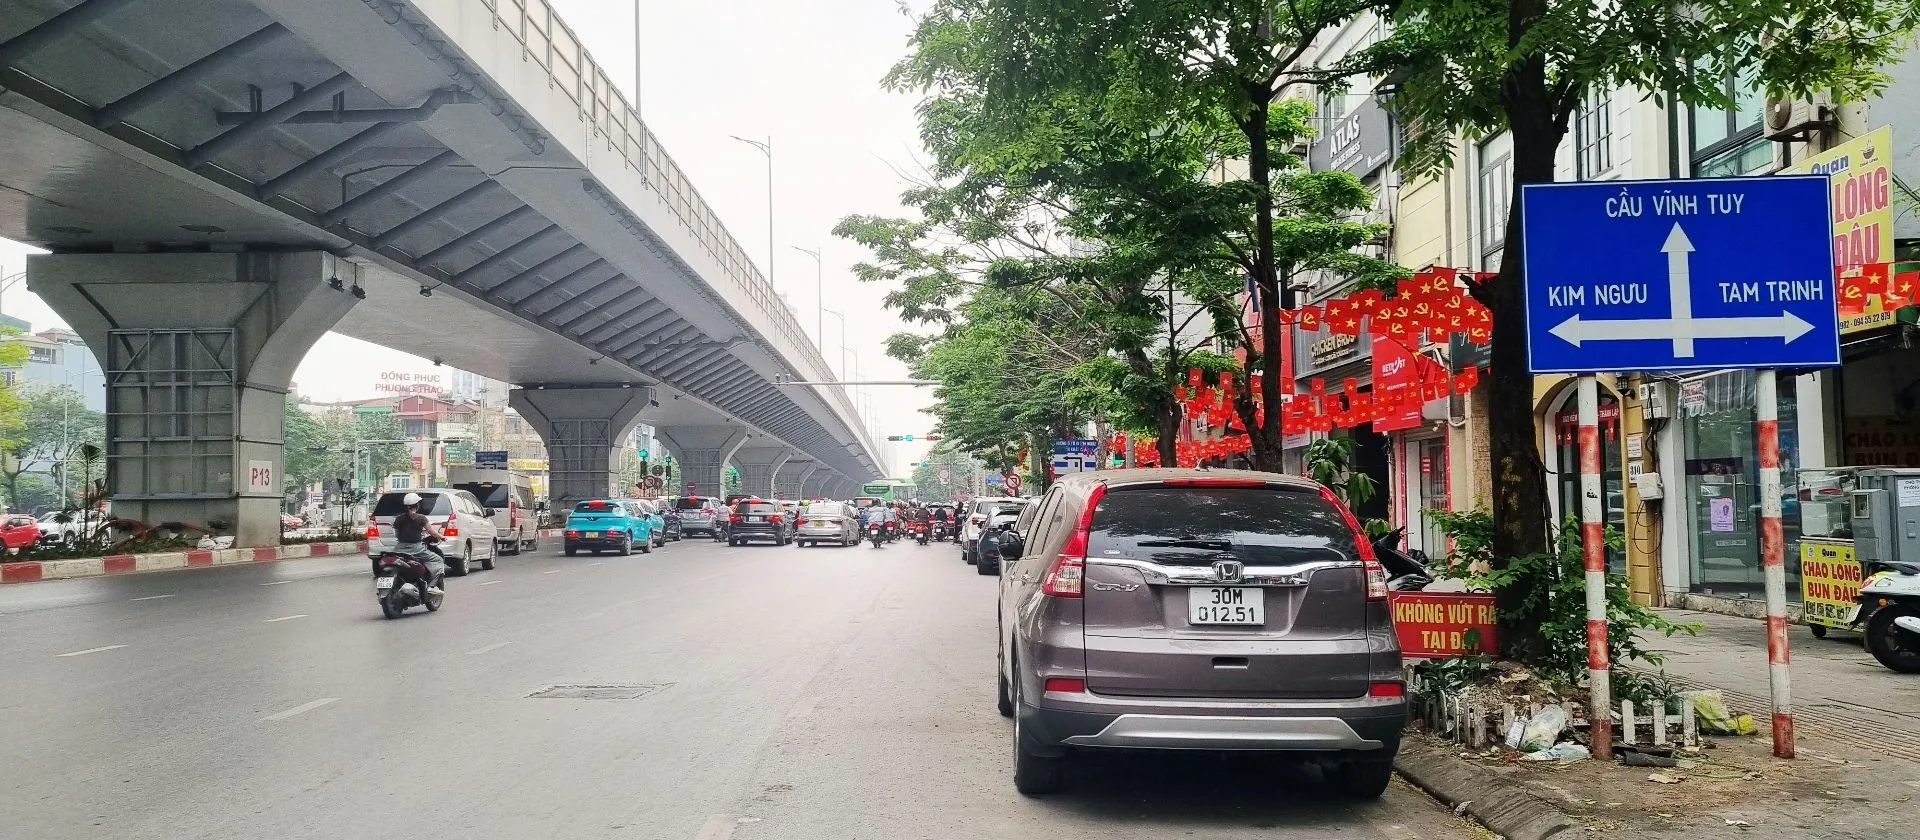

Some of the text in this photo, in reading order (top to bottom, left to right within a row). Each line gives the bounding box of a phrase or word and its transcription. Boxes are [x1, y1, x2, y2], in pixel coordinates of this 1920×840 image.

[1330, 115, 1360, 158] ATLAS
[1606, 187, 1745, 217] CẦU VĨNH TUY
[1834, 166, 1888, 223] LÒNG
[1548, 283, 1647, 307] KIM NGƯU
[1719, 279, 1823, 303] TAM TRINH
[252, 468, 270, 486] P13
[1211, 588, 1243, 605] 30M
[1198, 606, 1255, 622] 012.51
[1395, 600, 1498, 624] KHÔNG VỨT RÁ
[1421, 630, 1446, 653] TẠI
